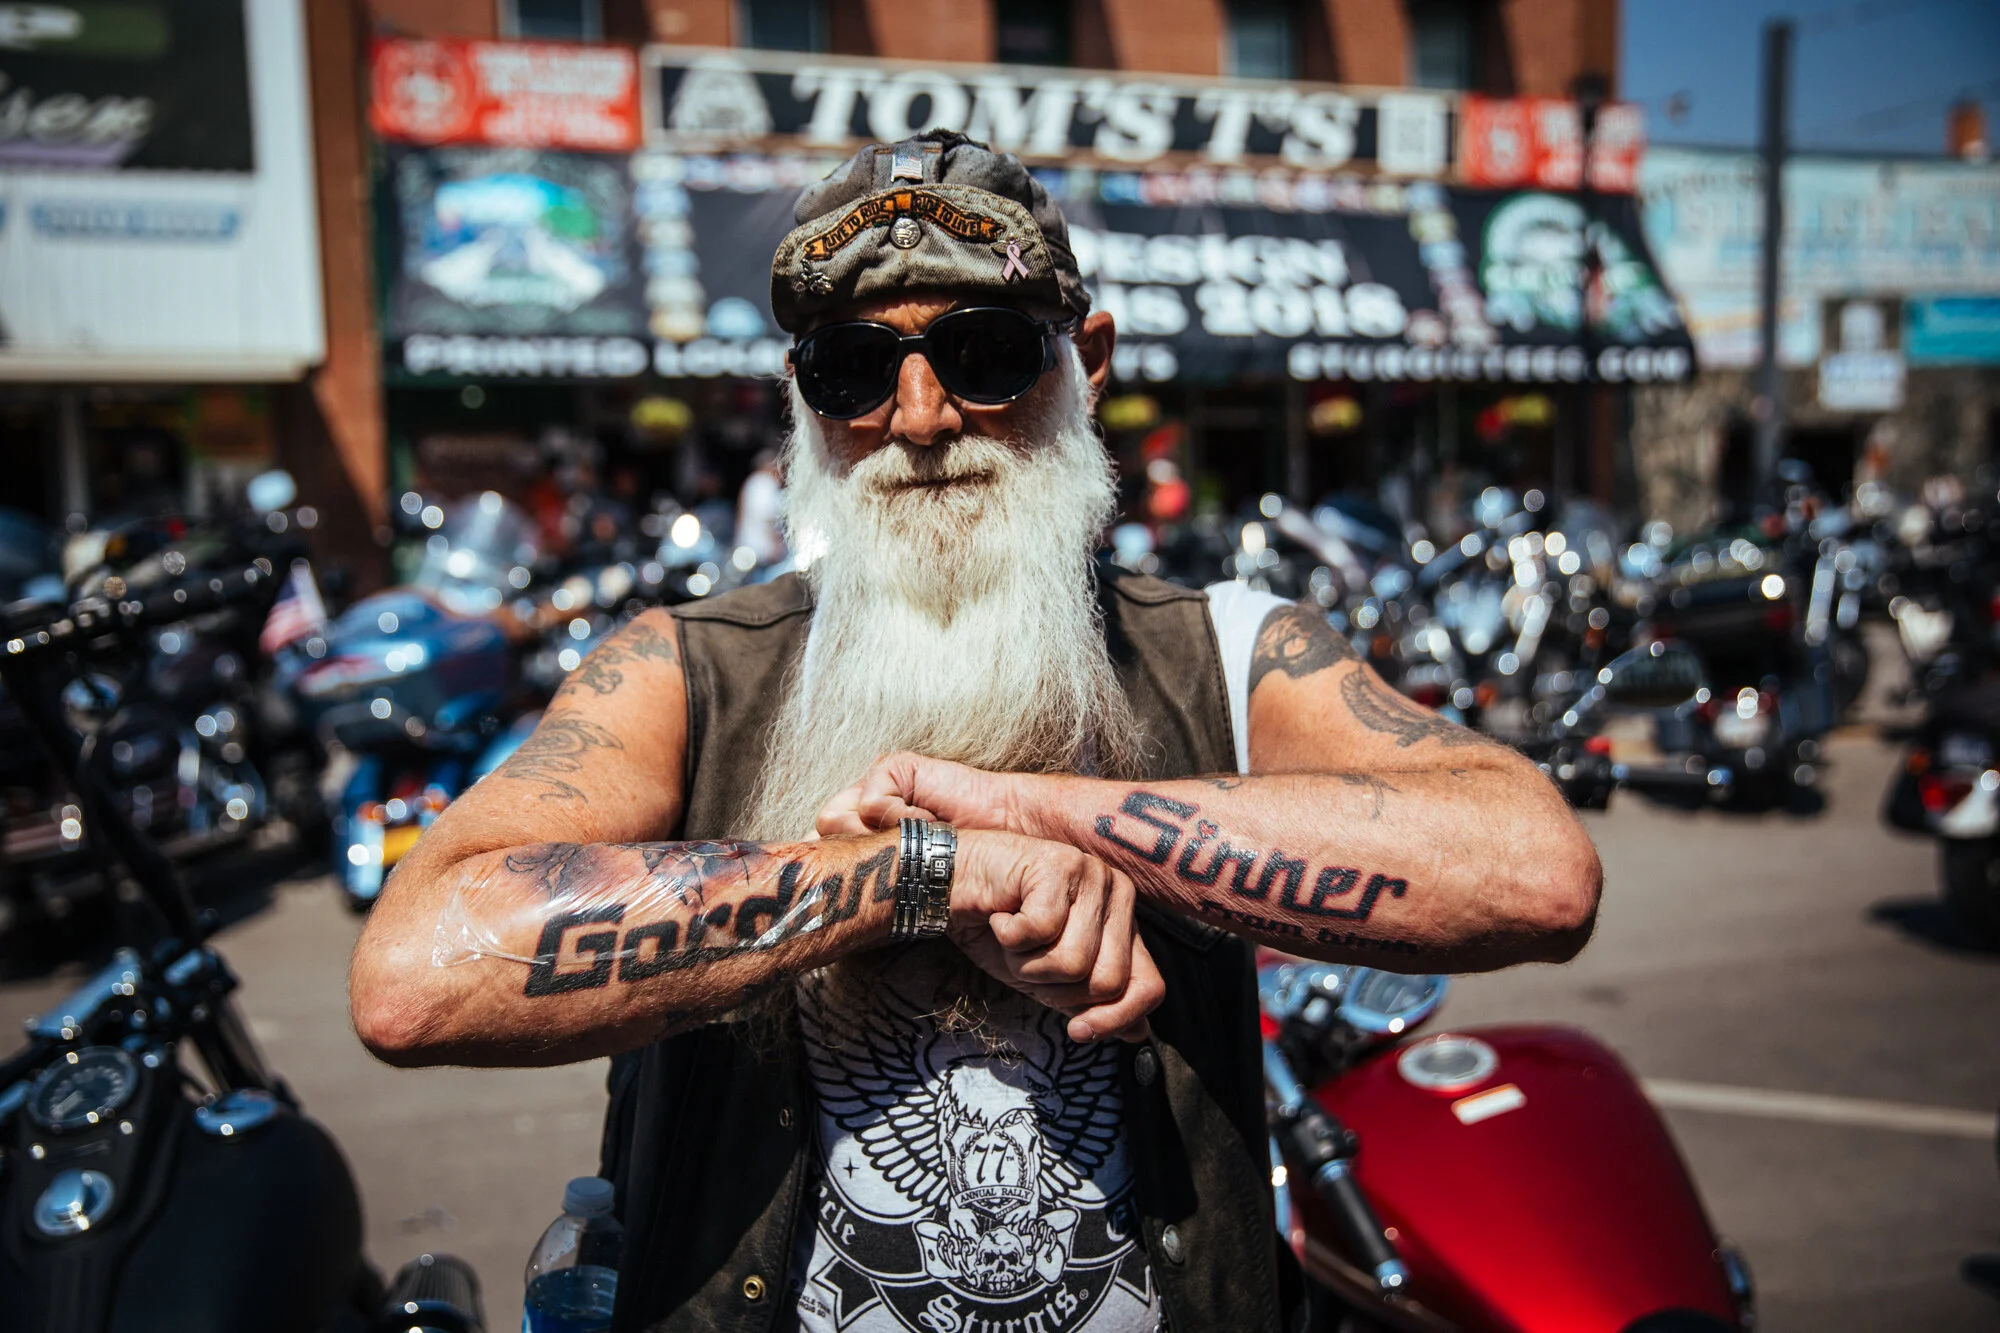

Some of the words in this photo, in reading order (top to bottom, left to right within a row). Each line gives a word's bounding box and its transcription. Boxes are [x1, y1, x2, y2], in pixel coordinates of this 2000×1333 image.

[792, 65, 1178, 162] TOM'S
[1197, 84, 1361, 170] T'S
[822, 225, 848, 251] LIVE
[847, 215, 860, 231] TO
[861, 200, 887, 219] RIDE
[935, 860, 946, 877] UB
[1094, 790, 1409, 921] Sinner
[961, 1188, 997, 1203] ANNUAL
[1001, 1187, 1031, 1200] RALLY
